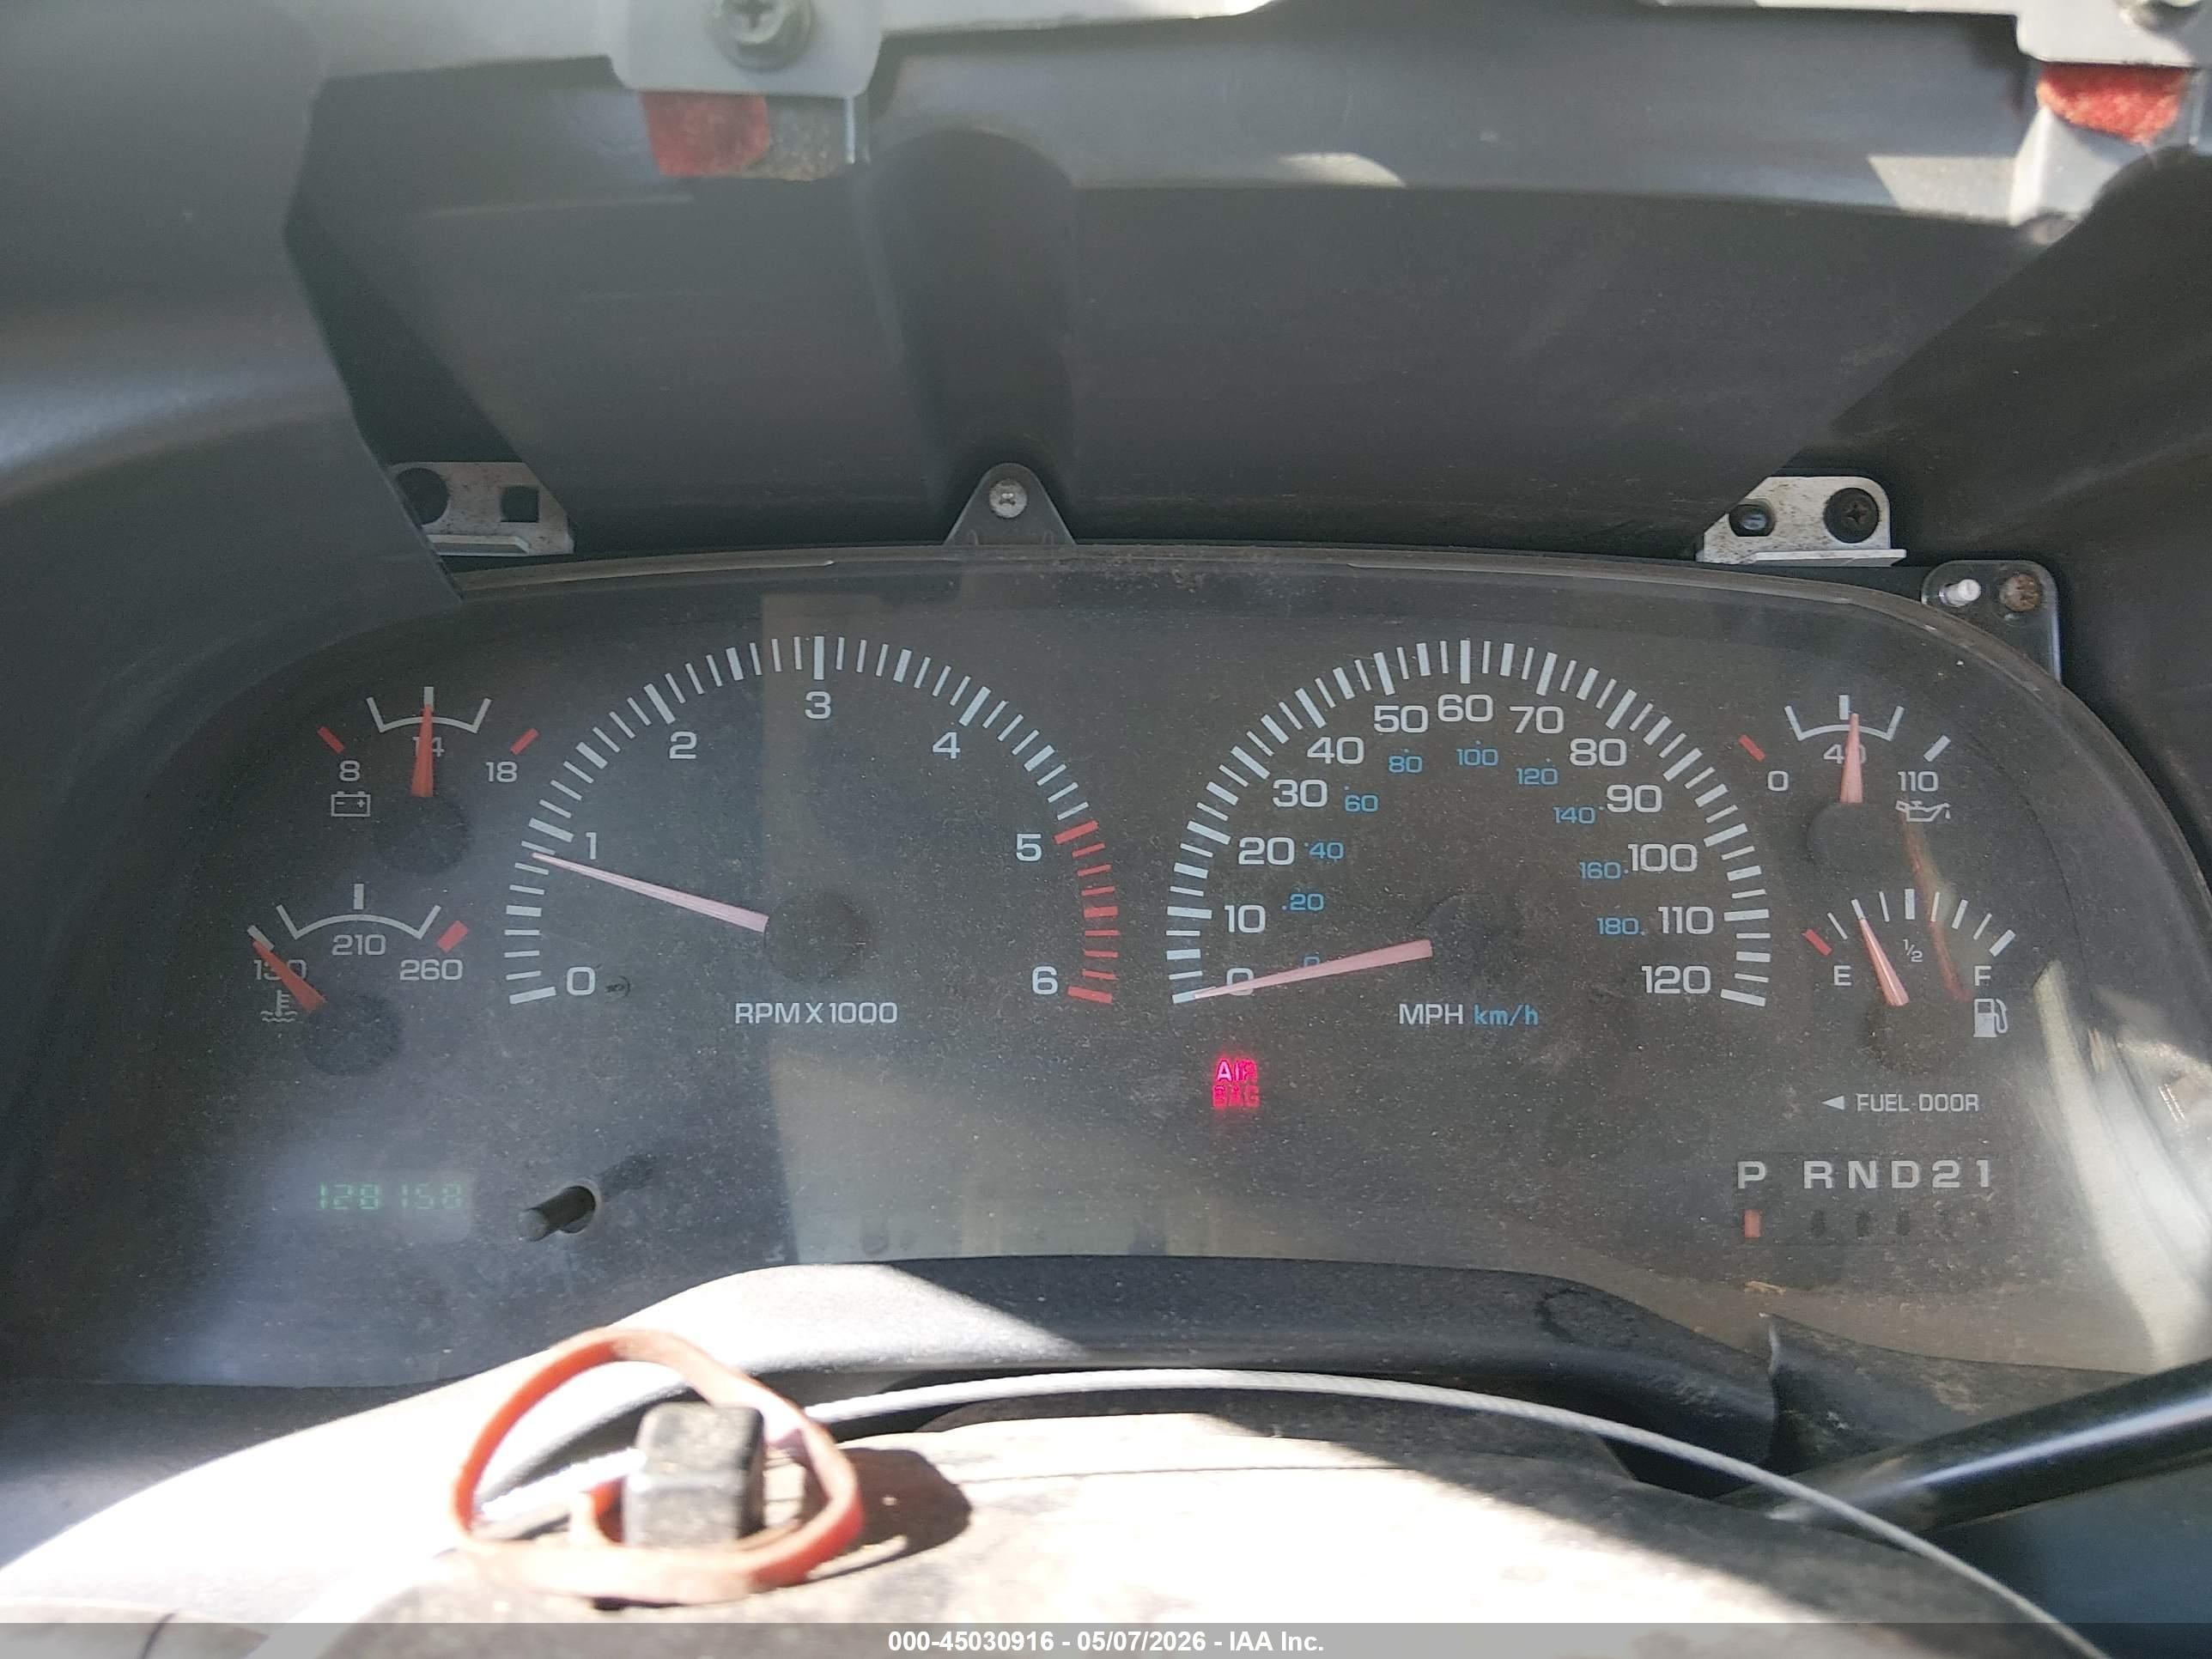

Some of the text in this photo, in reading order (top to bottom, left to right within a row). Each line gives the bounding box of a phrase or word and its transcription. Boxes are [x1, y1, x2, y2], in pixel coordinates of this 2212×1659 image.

[805, 691, 831, 720] 3
[1437, 694, 1493, 722] 60
[1373, 705, 1429, 733] 50
[1510, 706, 1564, 734] 70
[669, 731, 697, 759] 2
[933, 732, 961, 759] 4
[1307, 736, 1364, 764] 40
[1456, 748, 1498, 766] 100
[1570, 738, 1627, 767] 80
[339, 760, 361, 782] 8
[486, 761, 518, 783] 18
[1389, 756, 1423, 773] 80
[1516, 768, 1559, 785] 120
[1272, 778, 1328, 807] 30
[1767, 770, 1789, 792] 0
[1897, 770, 1939, 792] 110
[1345, 794, 1378, 812] 60
[1607, 784, 1662, 813] 90
[1553, 806, 1595, 824] 140
[586, 831, 597, 860] 1
[1016, 833, 1042, 862] 5
[1238, 836, 1295, 866] 20
[1309, 842, 1344, 860] 40
[1627, 843, 1698, 872] 100
[1579, 861, 1621, 879] 160
[1290, 893, 1324, 911] 20
[1224, 904, 1266, 933] 10
[1596, 917, 1638, 935] 180
[1657, 906, 1714, 935] 110
[331, 933, 386, 956] 210
[399, 958, 463, 981] 260
[566, 966, 596, 996] 0
[1032, 966, 1058, 995] 6
[1225, 967, 1255, 996] 0
[1641, 965, 1711, 994] 120
[1833, 965, 1851, 986] E
[1974, 965, 1991, 987] F
[735, 1002, 897, 1024] RPM X 1000
[1399, 1003, 1539, 1026] MPH km/h
[1856, 1092, 1979, 1112] FUEL DOOR
